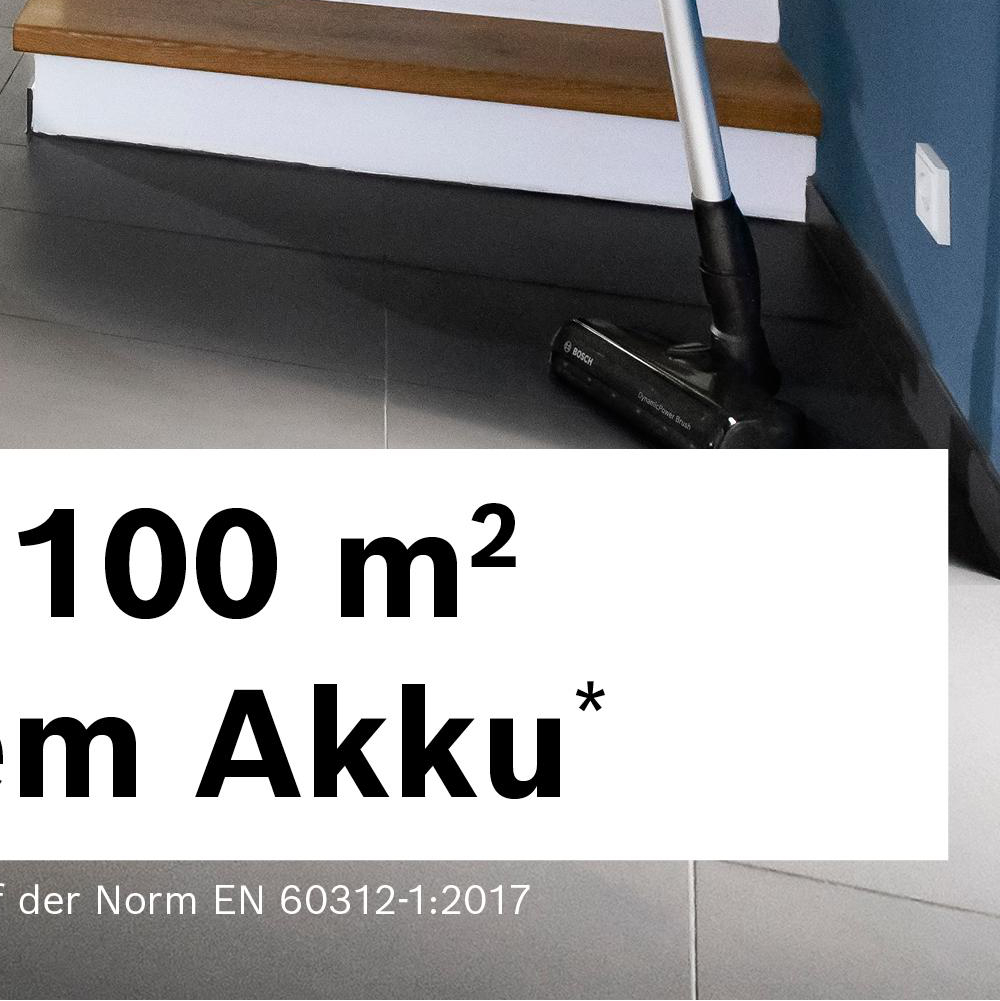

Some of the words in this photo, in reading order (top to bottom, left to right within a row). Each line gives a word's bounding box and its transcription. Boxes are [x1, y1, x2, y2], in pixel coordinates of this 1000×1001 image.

[572, 347, 594, 366] BOSCH
[637, 391, 676, 423] DynamicPower
[675, 415, 692, 431] Brush
